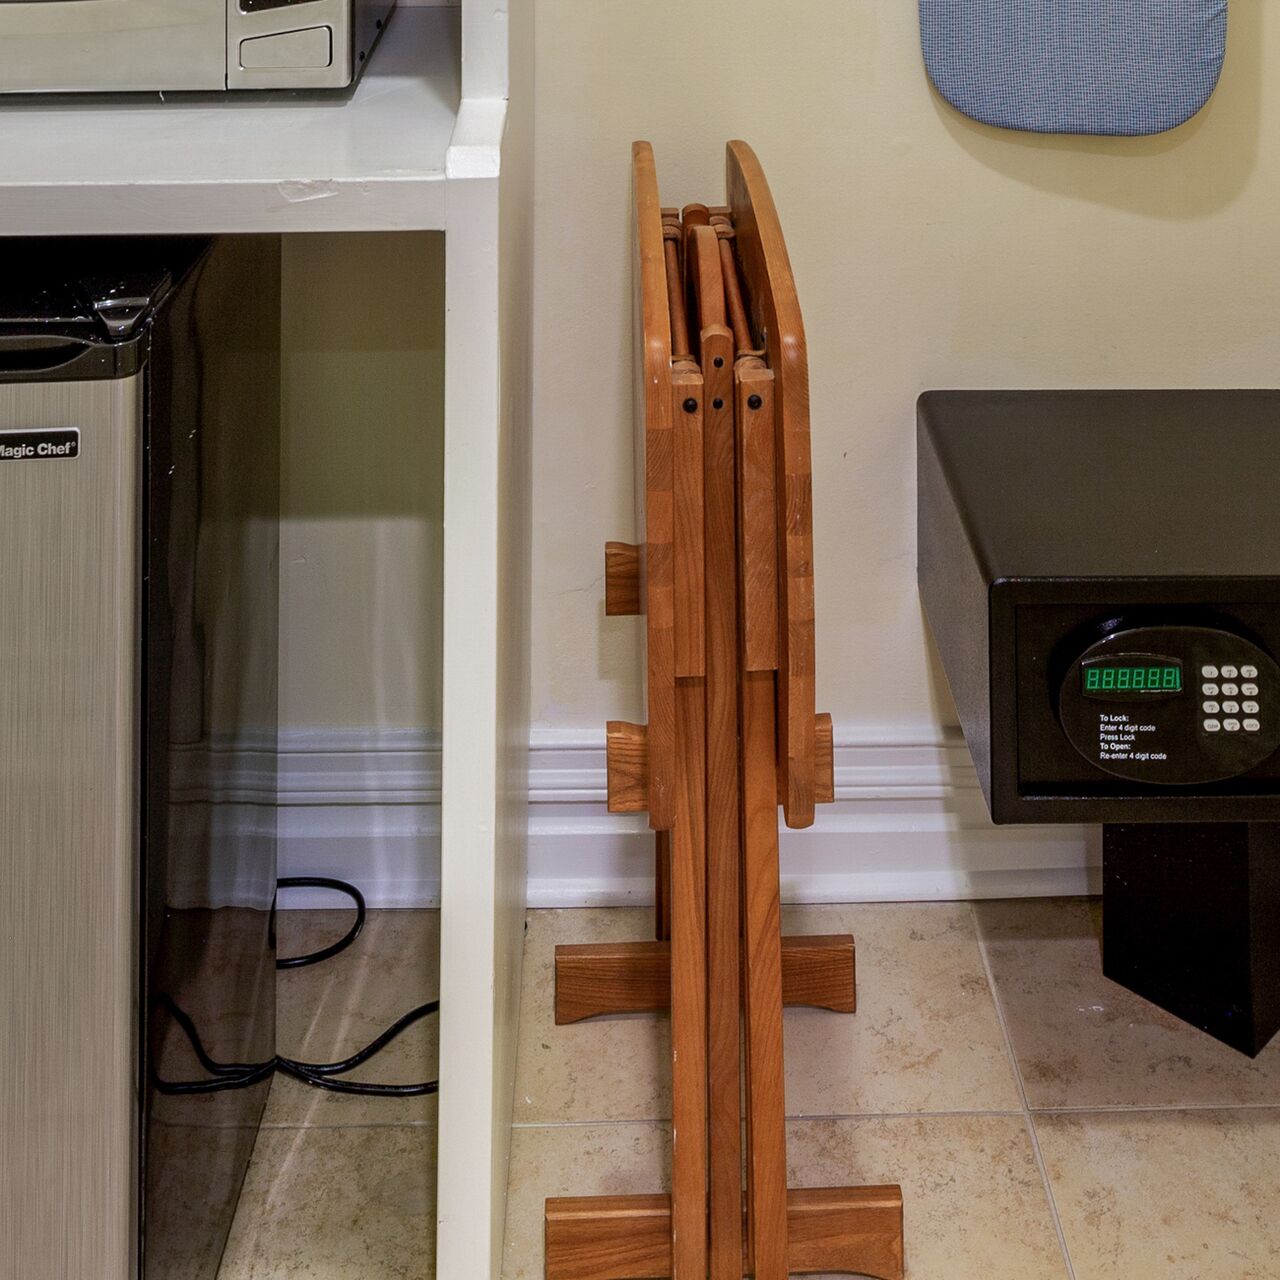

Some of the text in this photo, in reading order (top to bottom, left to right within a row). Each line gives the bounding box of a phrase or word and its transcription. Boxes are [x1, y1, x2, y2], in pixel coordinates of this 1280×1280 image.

[37, 442, 71, 455] Chef
[1100, 714, 1129, 722] To Lock:
[1124, 724, 1138, 732] digit
[1140, 724, 1156, 732] code
[1110, 743, 1131, 751] Open:
[1135, 752, 1149, 760] digit
